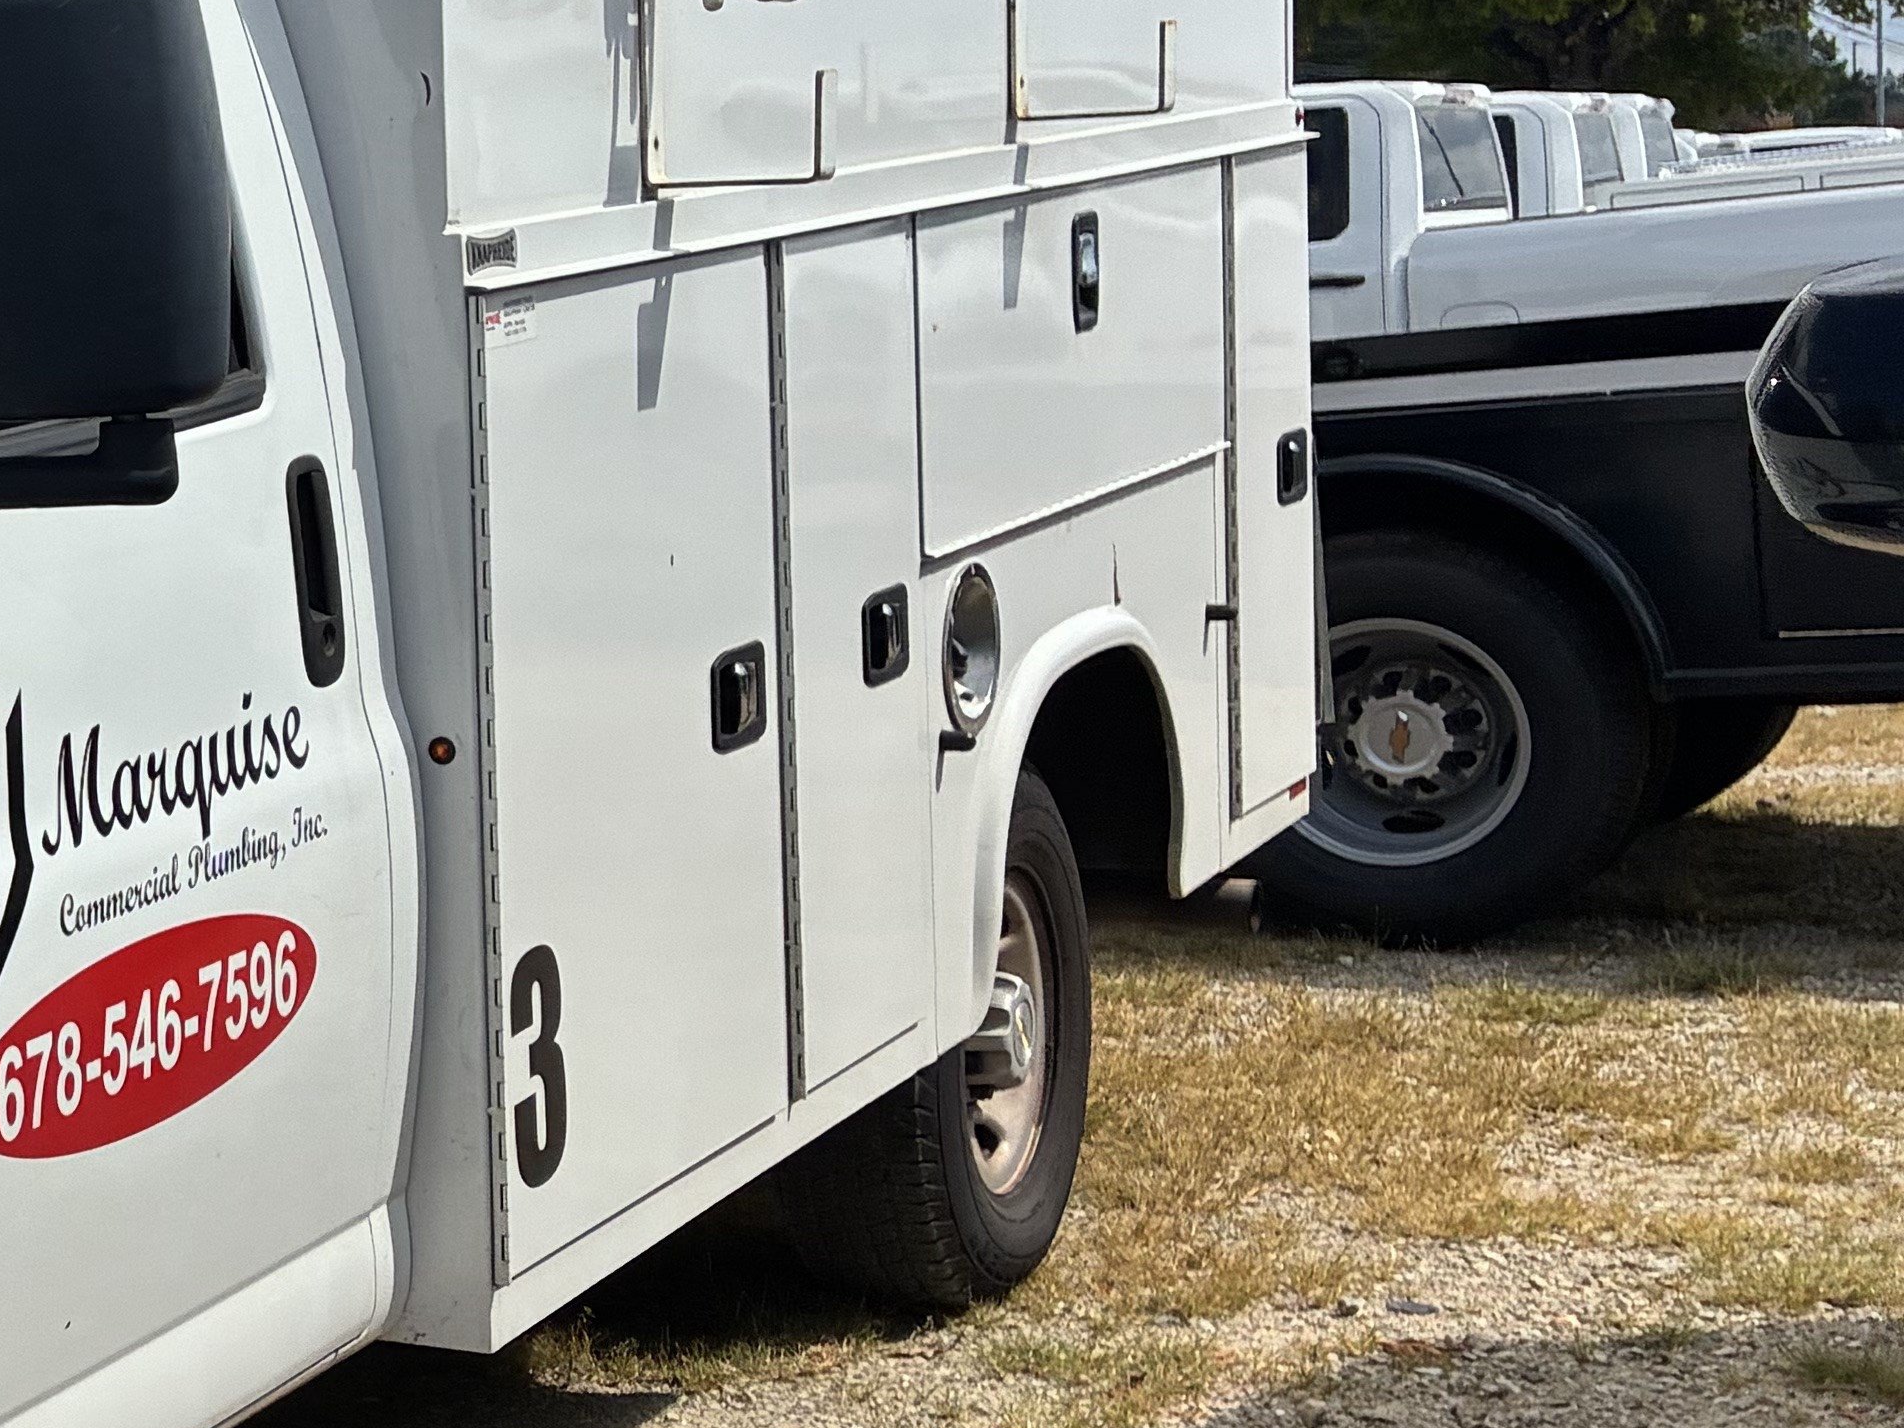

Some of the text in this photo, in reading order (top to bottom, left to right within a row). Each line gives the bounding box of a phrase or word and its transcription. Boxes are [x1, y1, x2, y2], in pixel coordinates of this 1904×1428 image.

[42, 692, 310, 856] Marquise
[59, 806, 328, 937] Commercial Plumbing, Inc.
[509, 944, 567, 1189] 3
